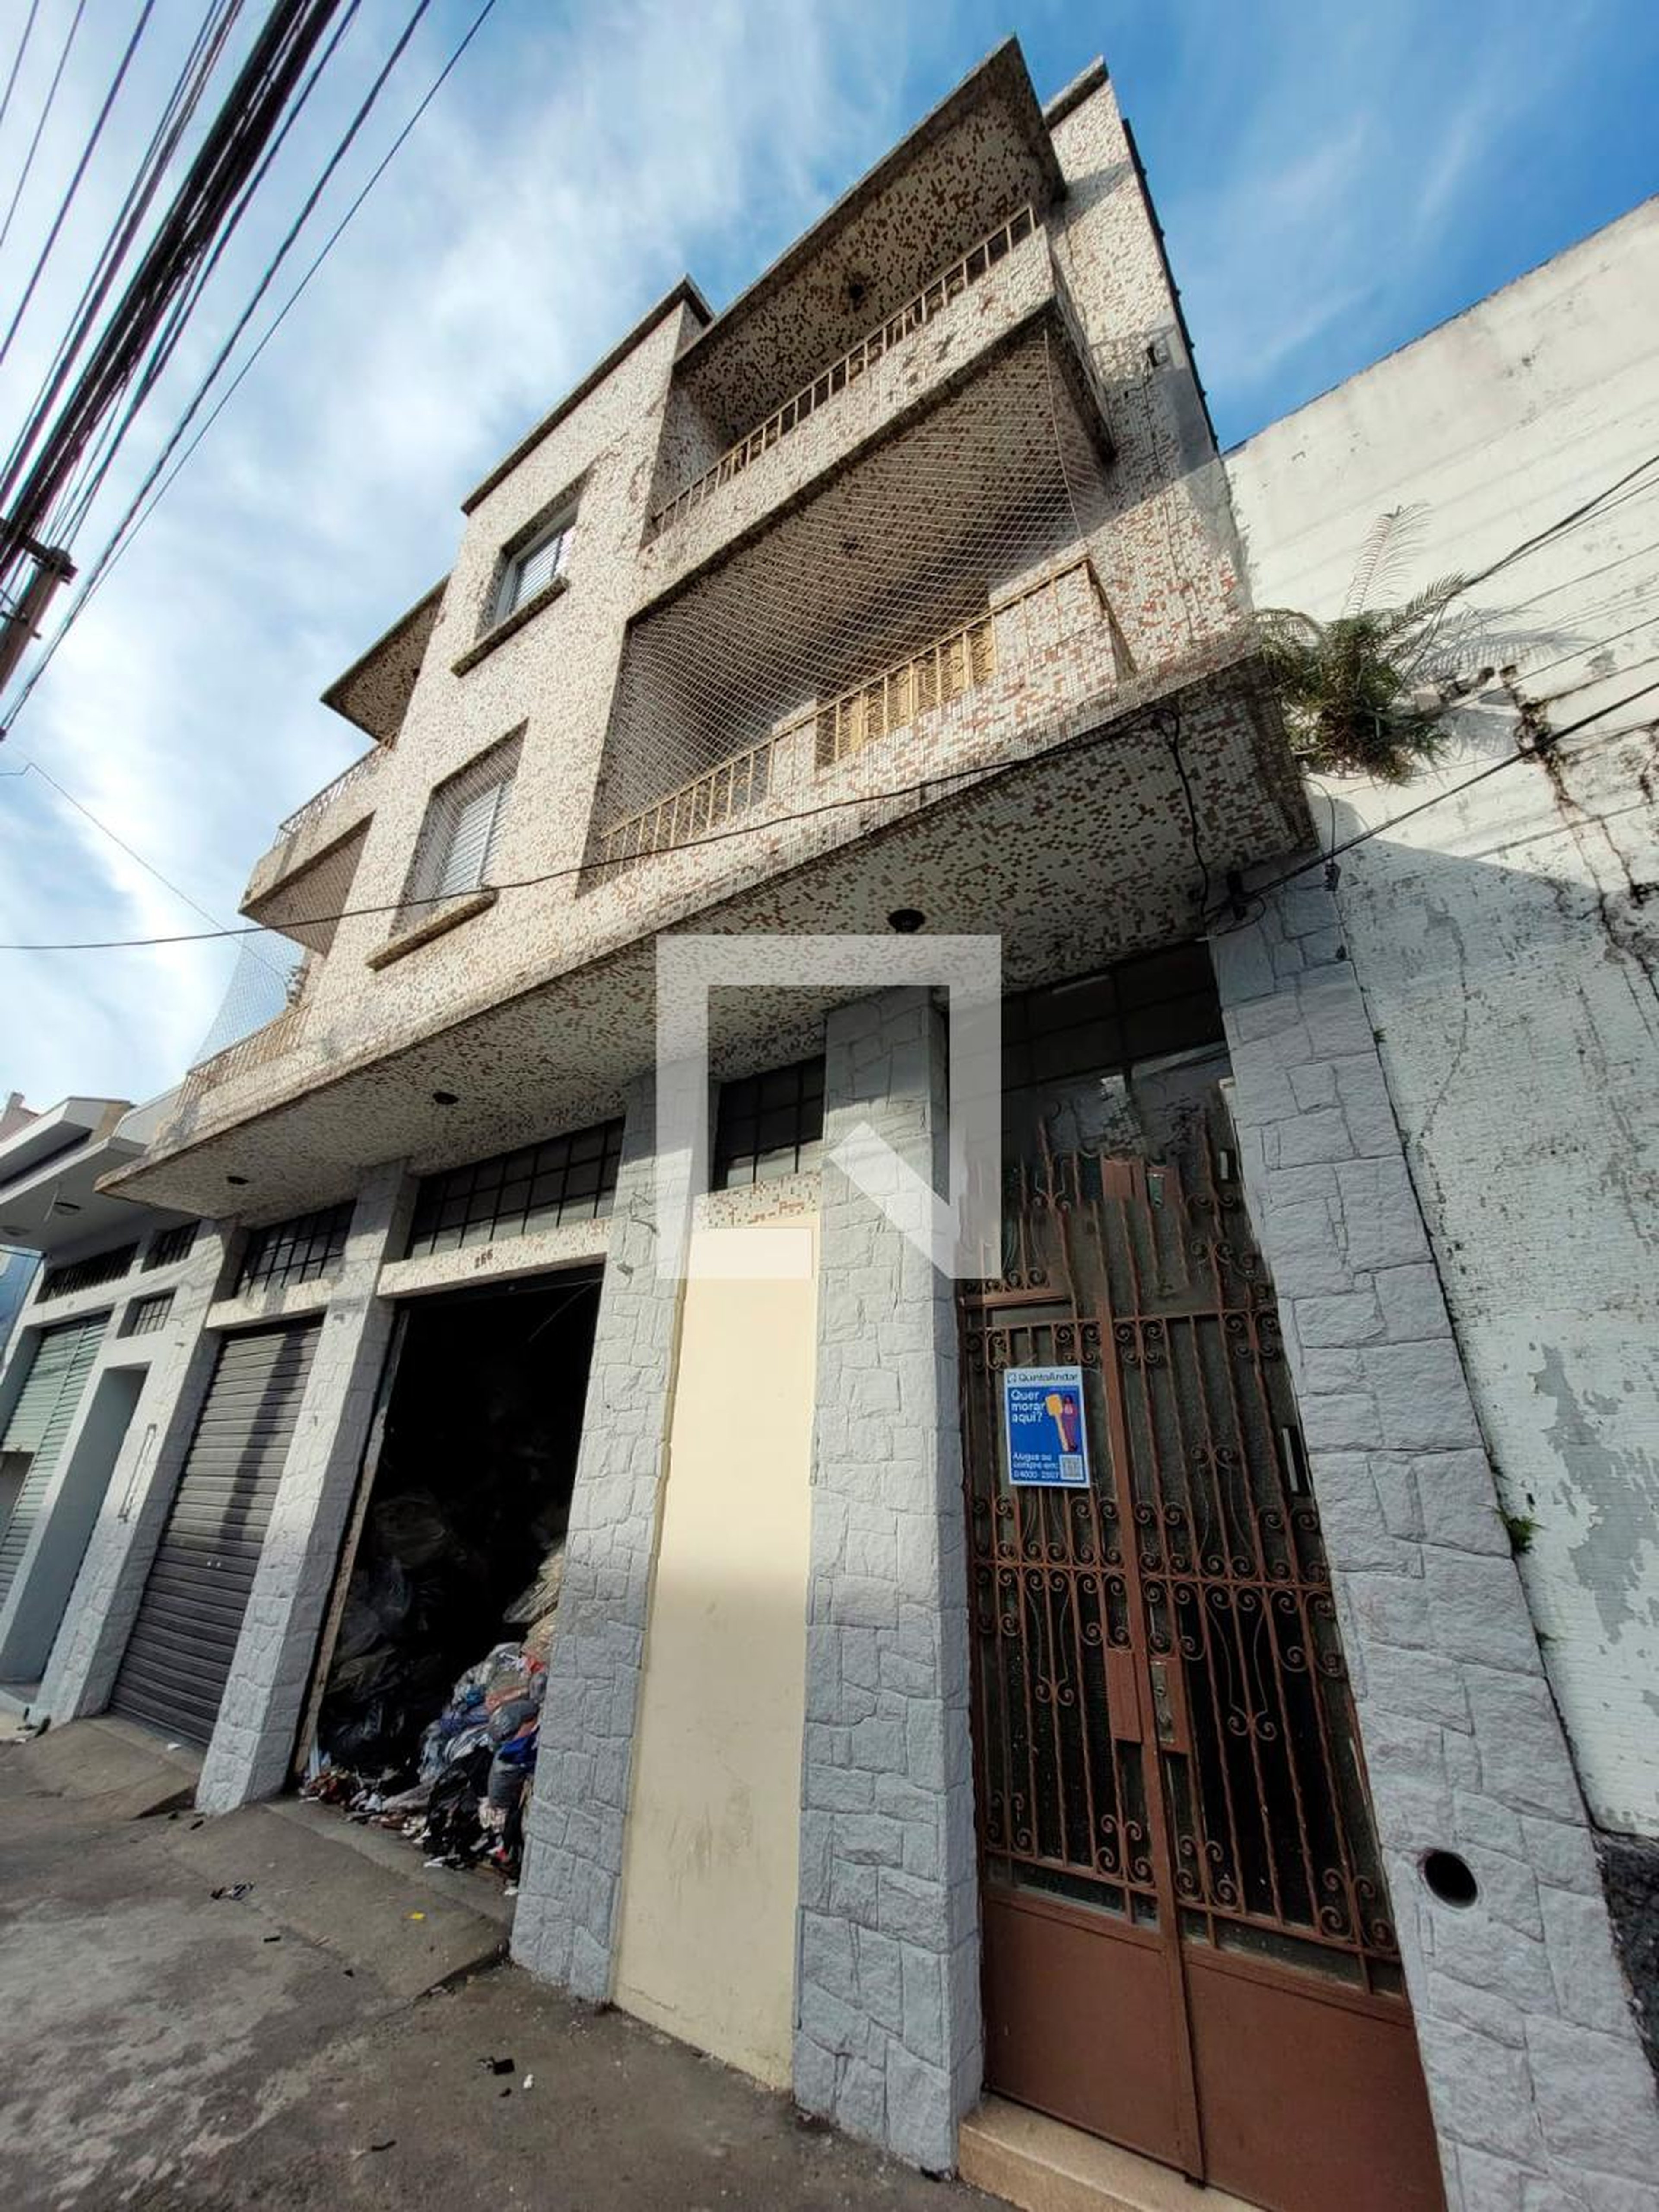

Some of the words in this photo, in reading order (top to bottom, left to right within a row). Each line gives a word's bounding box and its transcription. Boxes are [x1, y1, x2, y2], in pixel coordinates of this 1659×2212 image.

[1011, 1389, 1039, 1401] Quer
[1011, 1402, 1046, 1411] morar
[1012, 1411, 1042, 1425] aqui?
